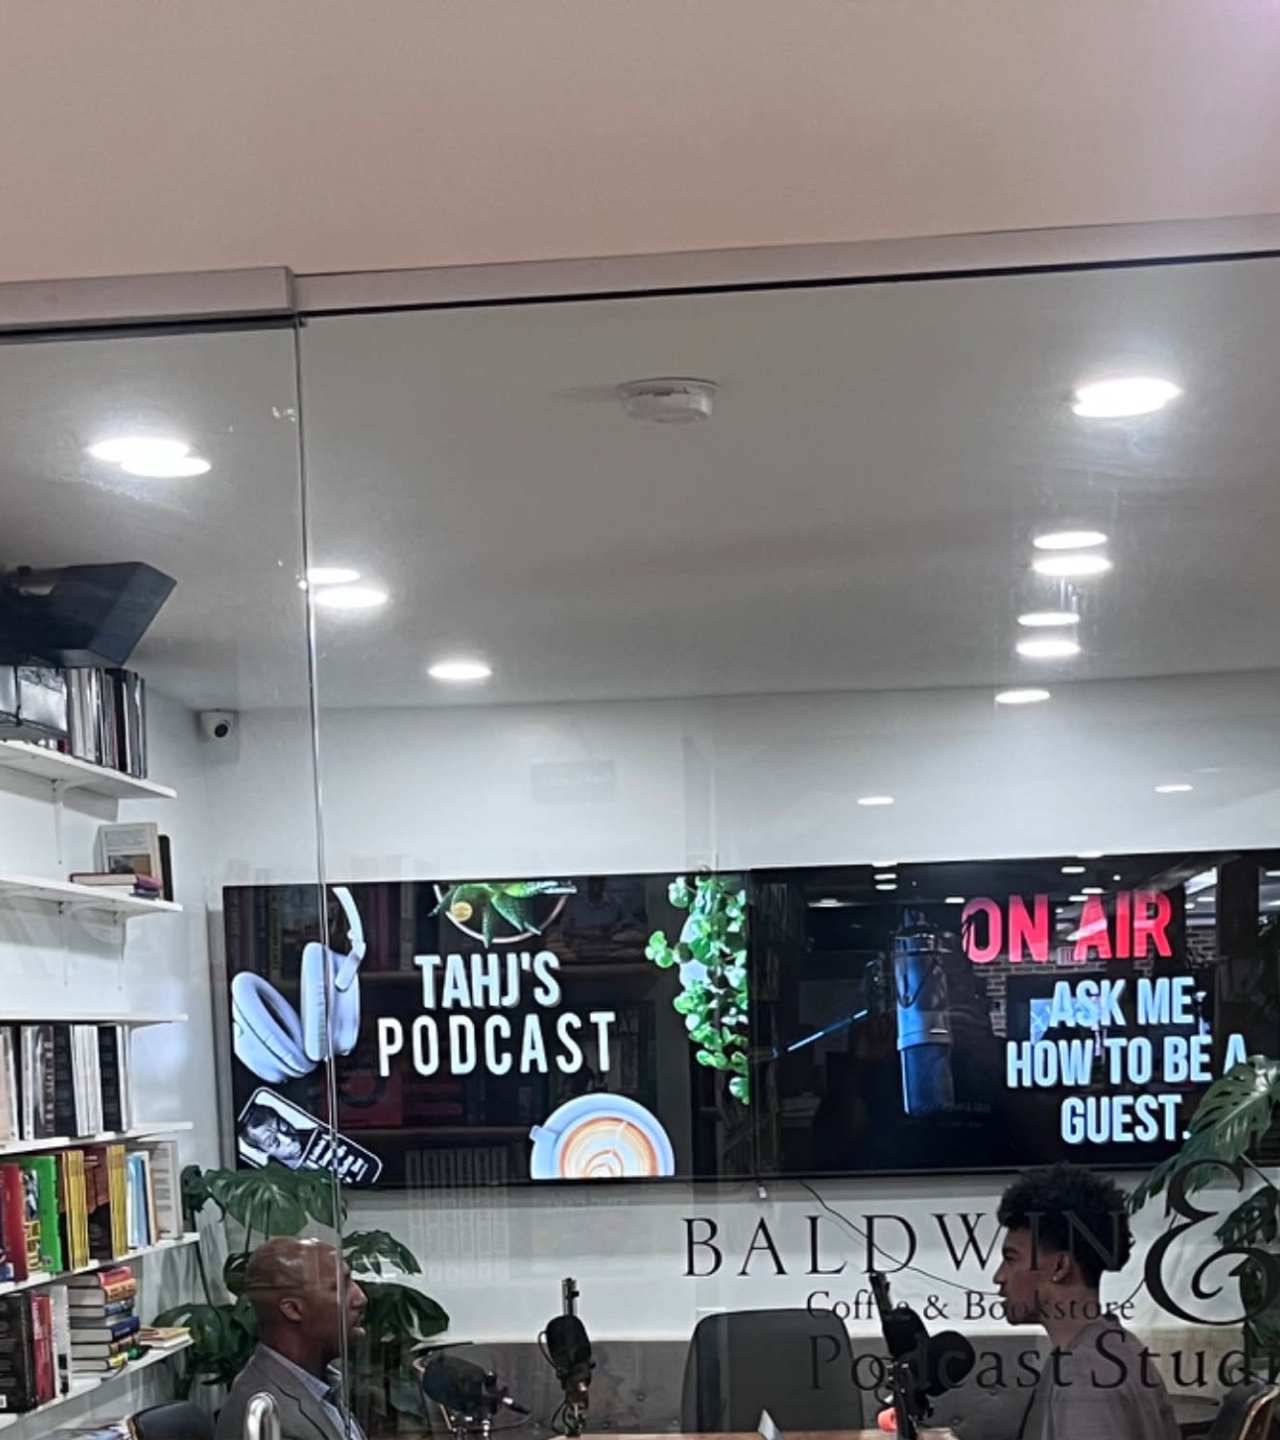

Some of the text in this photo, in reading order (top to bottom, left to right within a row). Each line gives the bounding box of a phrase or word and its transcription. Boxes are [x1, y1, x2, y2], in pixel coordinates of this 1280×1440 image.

[962, 890, 1174, 964] ON AIR
[414, 950, 562, 1010] TAHJ'S
[1049, 975, 1197, 1029] ASK ME
[376, 1010, 617, 1077] PODCAST
[1006, 1031, 1248, 1089] HOW TO BE A
[1060, 1093, 1193, 1144] GUEST.
[682, 1210, 1123, 1278] BALDWIN
[806, 1288, 1137, 1322] Coffe & Bookstore
